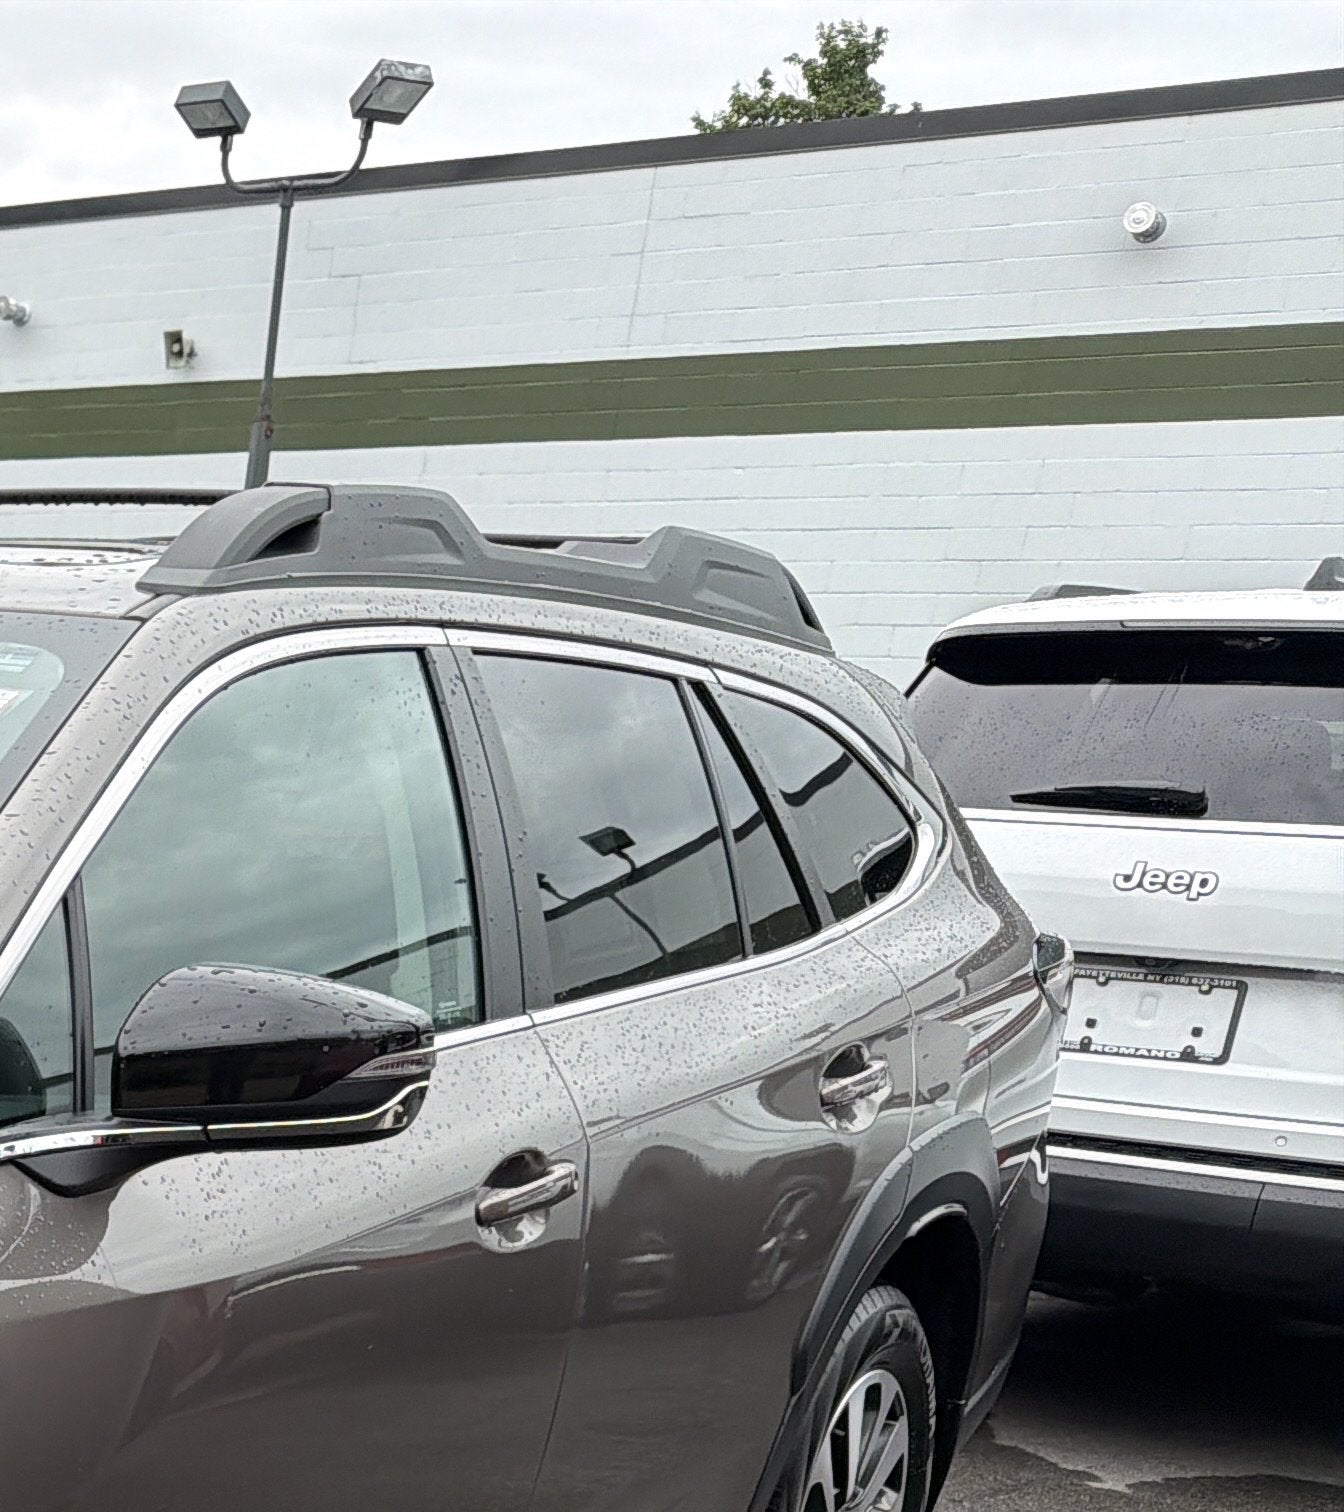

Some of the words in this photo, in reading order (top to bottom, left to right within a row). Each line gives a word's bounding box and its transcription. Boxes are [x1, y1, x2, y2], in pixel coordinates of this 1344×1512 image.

[1113, 860, 1220, 901] Jeep
[1073, 968, 1145, 981] FAYETTEVILLE
[1146, 974, 1163, 982] NY
[1089, 1043, 1181, 1059] ROMANO
